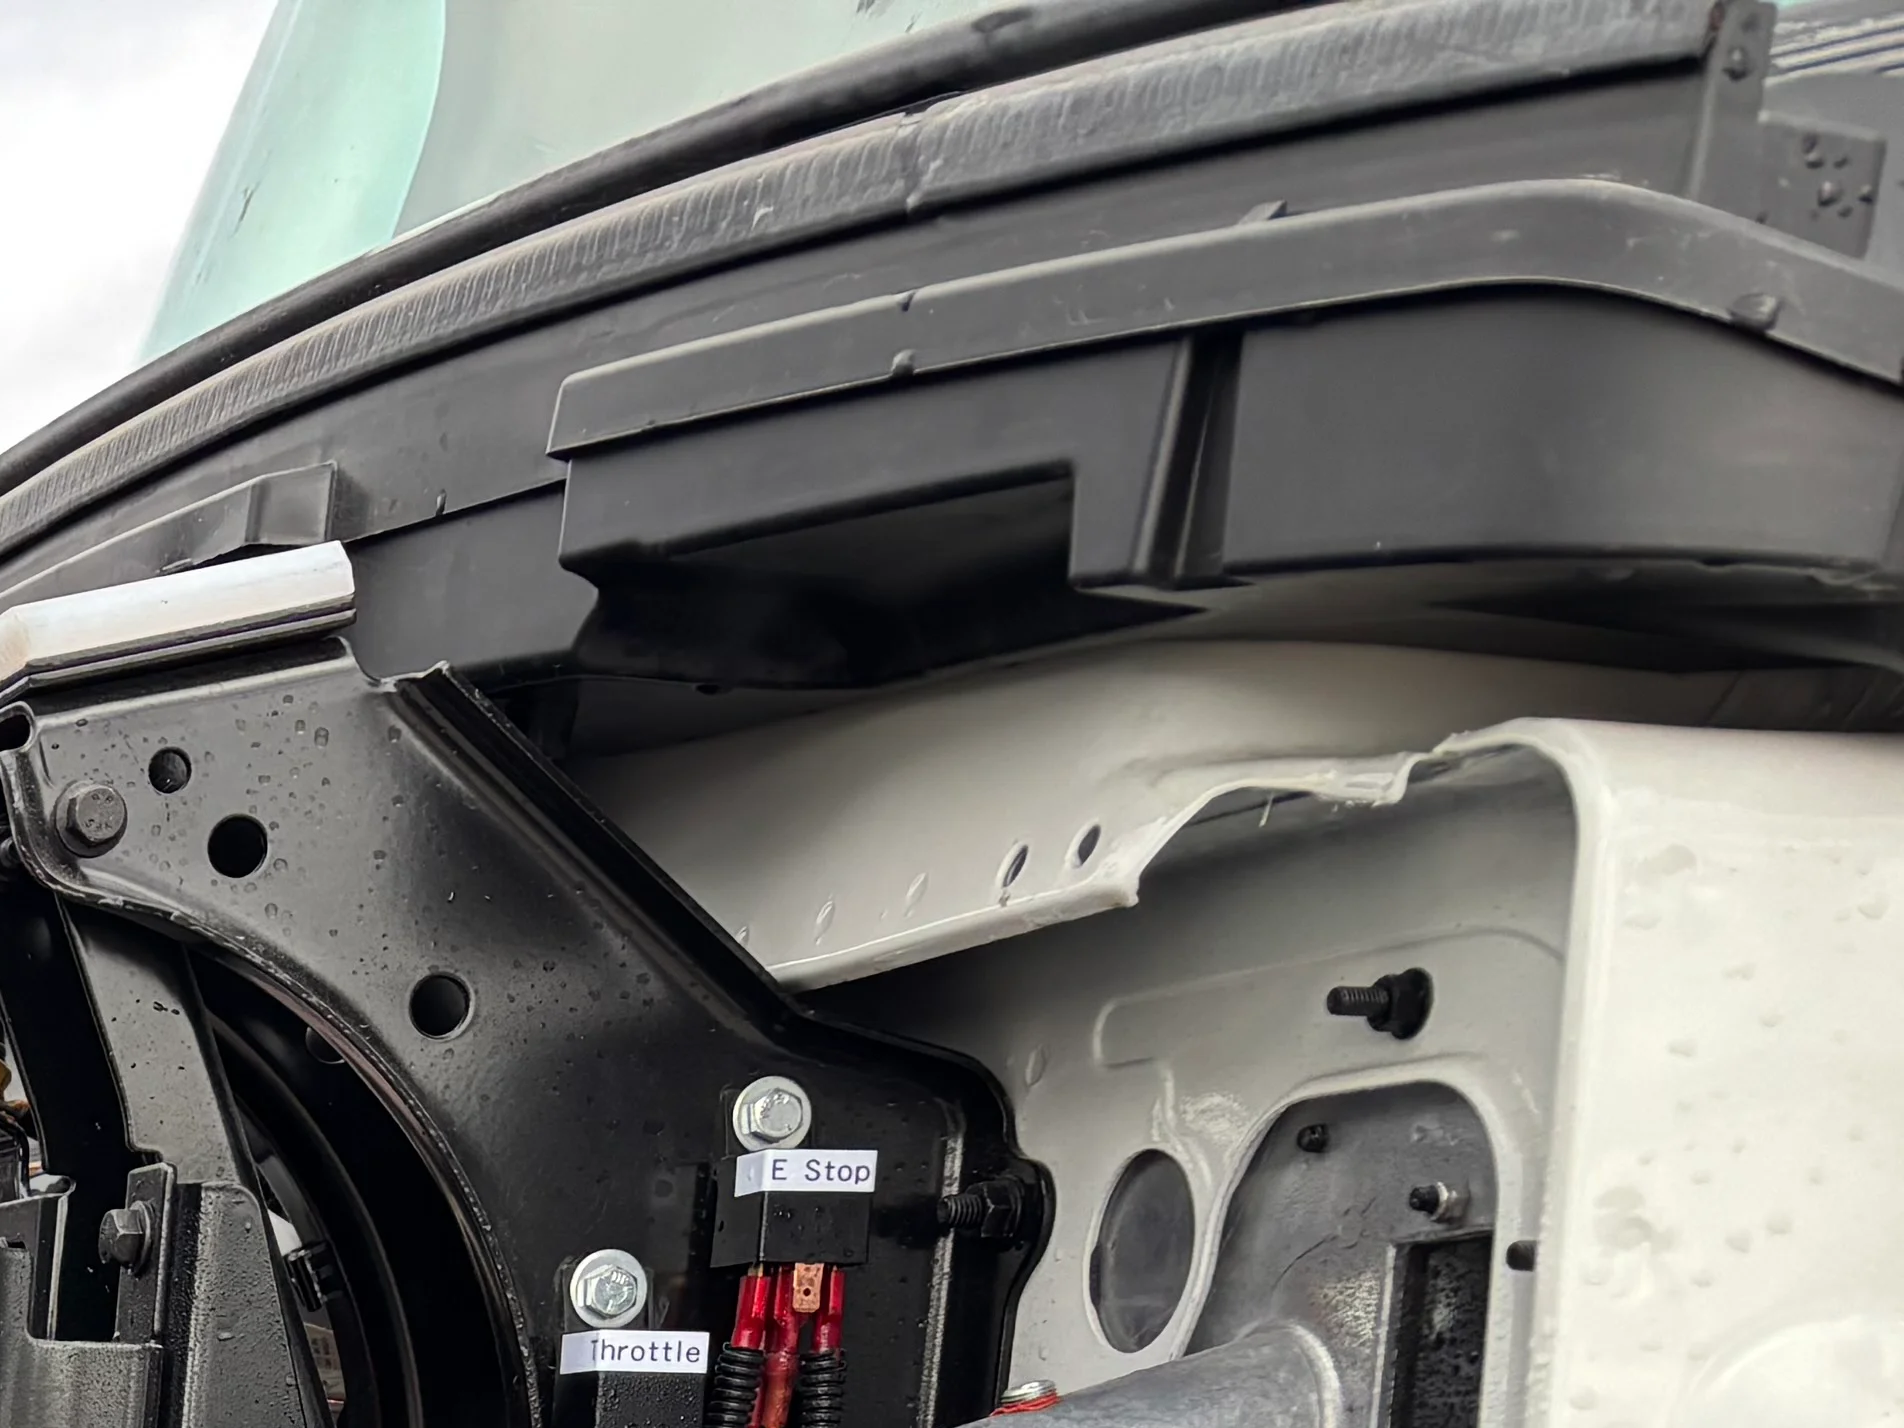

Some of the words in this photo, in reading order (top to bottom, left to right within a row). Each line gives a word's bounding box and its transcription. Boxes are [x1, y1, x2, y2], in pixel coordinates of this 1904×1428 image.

[770, 1158, 788, 1181] E
[804, 1159, 872, 1185] Stop
[590, 1339, 701, 1363] Throttle
